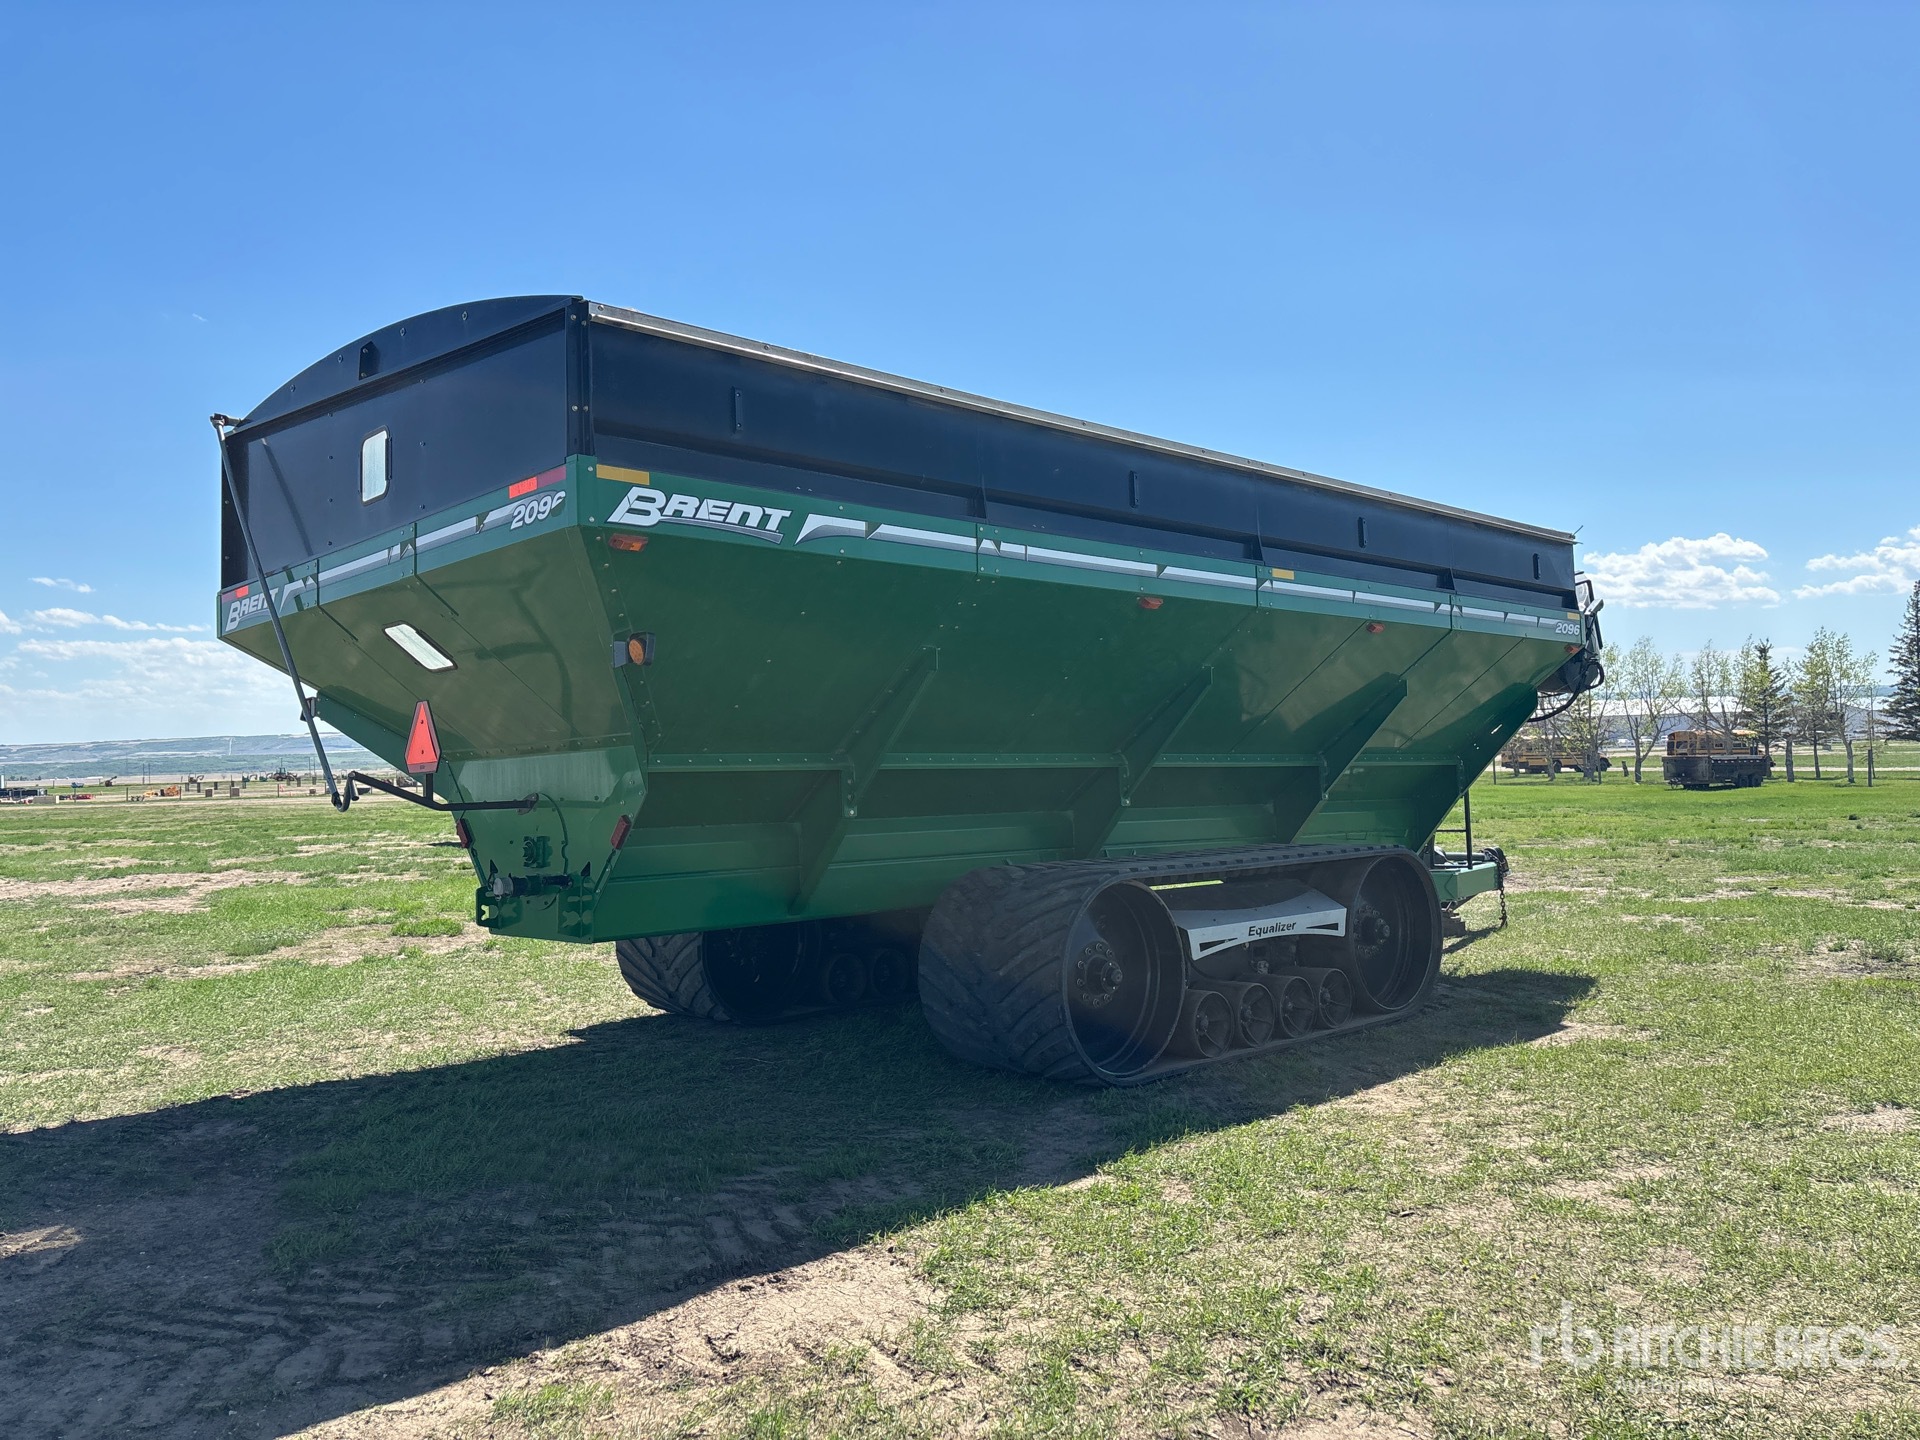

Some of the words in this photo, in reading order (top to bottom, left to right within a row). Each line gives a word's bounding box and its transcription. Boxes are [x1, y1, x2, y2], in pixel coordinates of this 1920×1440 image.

[607, 486, 792, 532] BRENT
[1555, 622, 1580, 635] 2096
[1248, 921, 1297, 937] Equalizer
